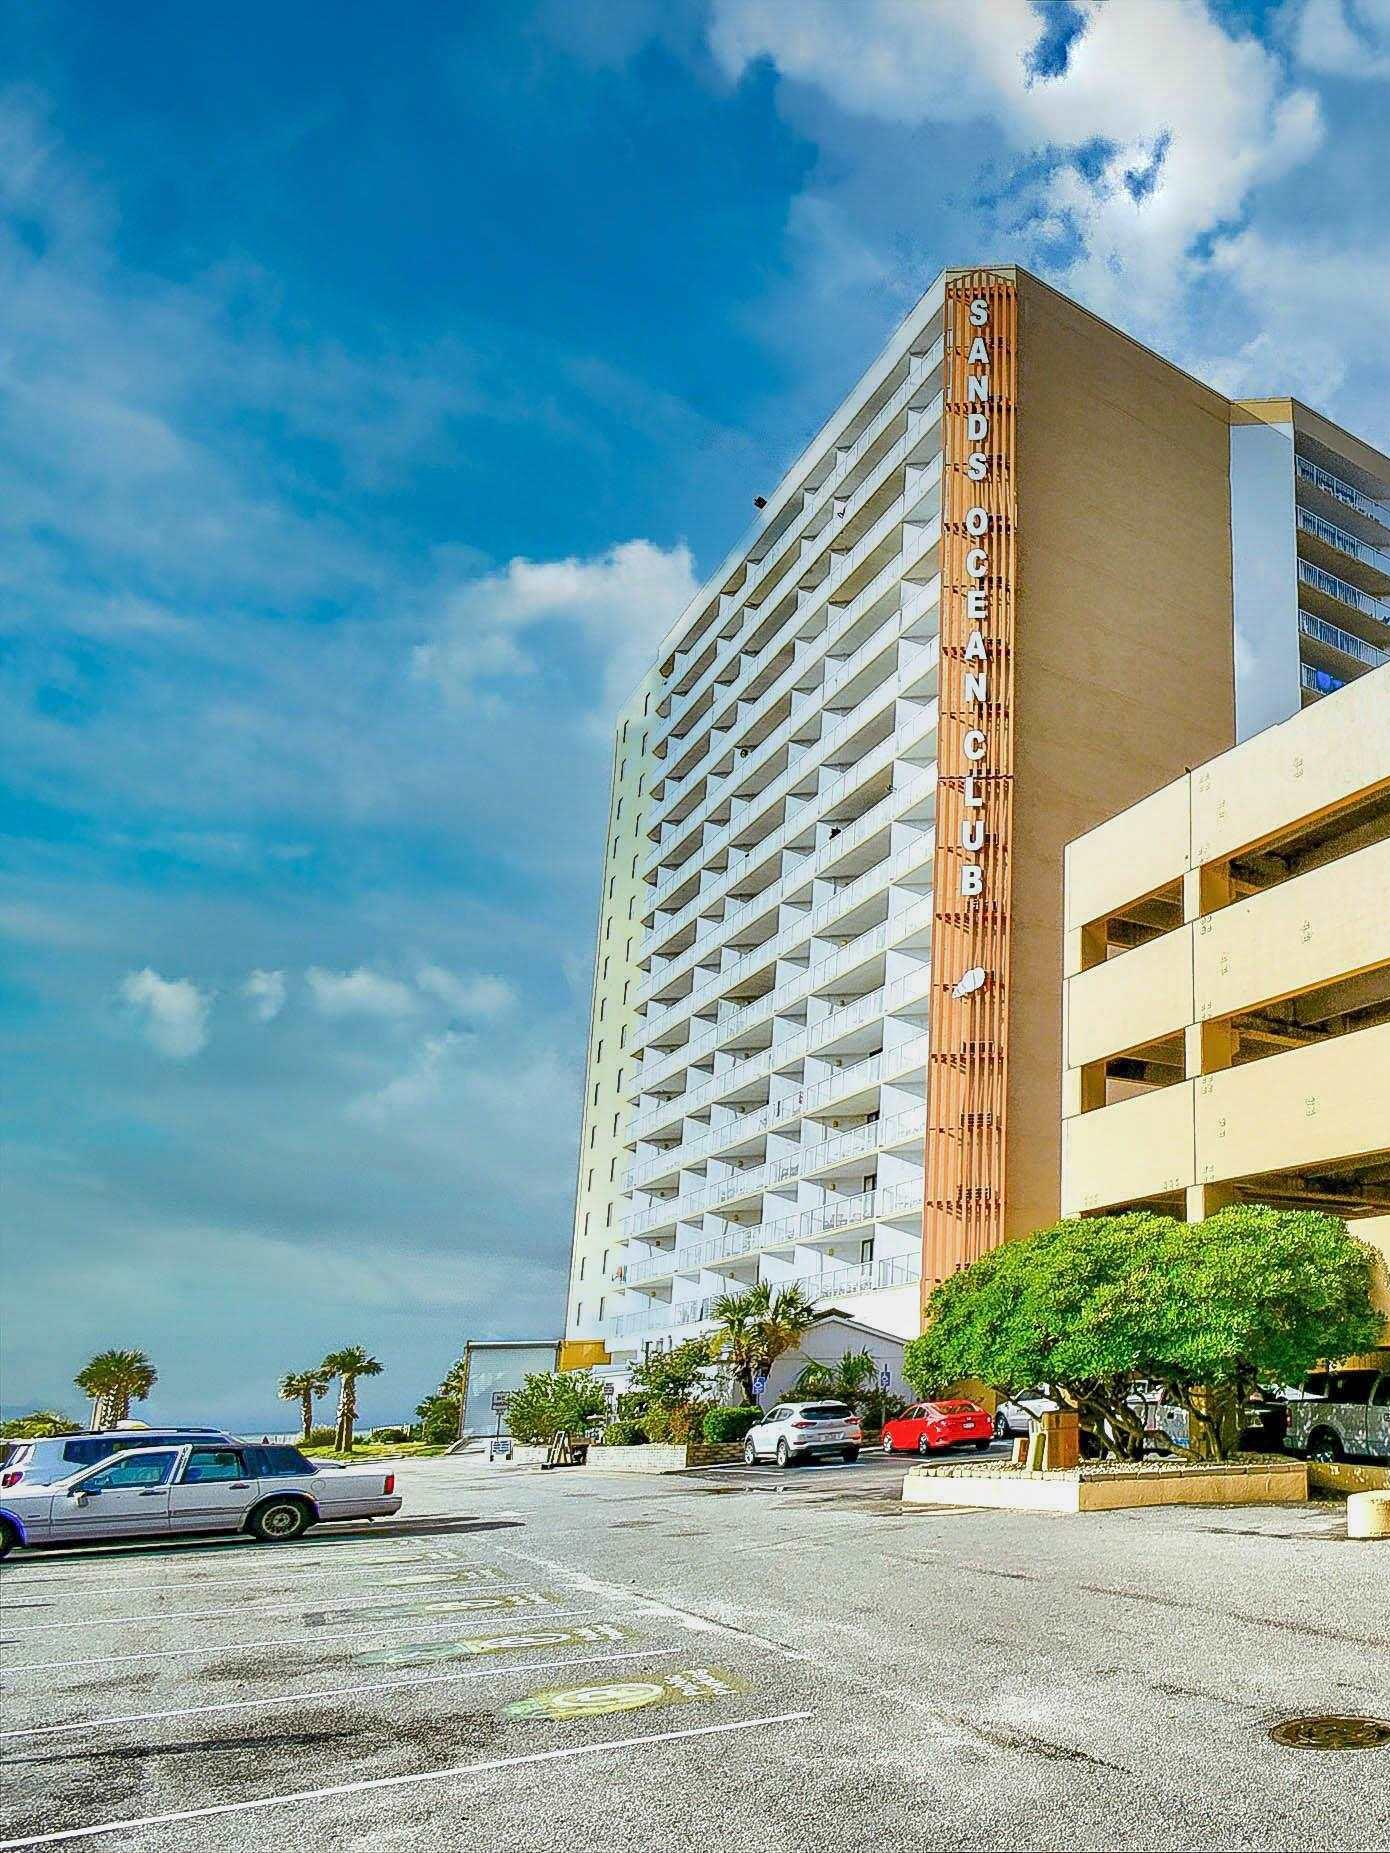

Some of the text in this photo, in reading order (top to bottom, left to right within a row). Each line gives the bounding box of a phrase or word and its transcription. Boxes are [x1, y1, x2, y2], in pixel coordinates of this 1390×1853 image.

[960, 298, 990, 897] SANDS OCEAN CLUB
